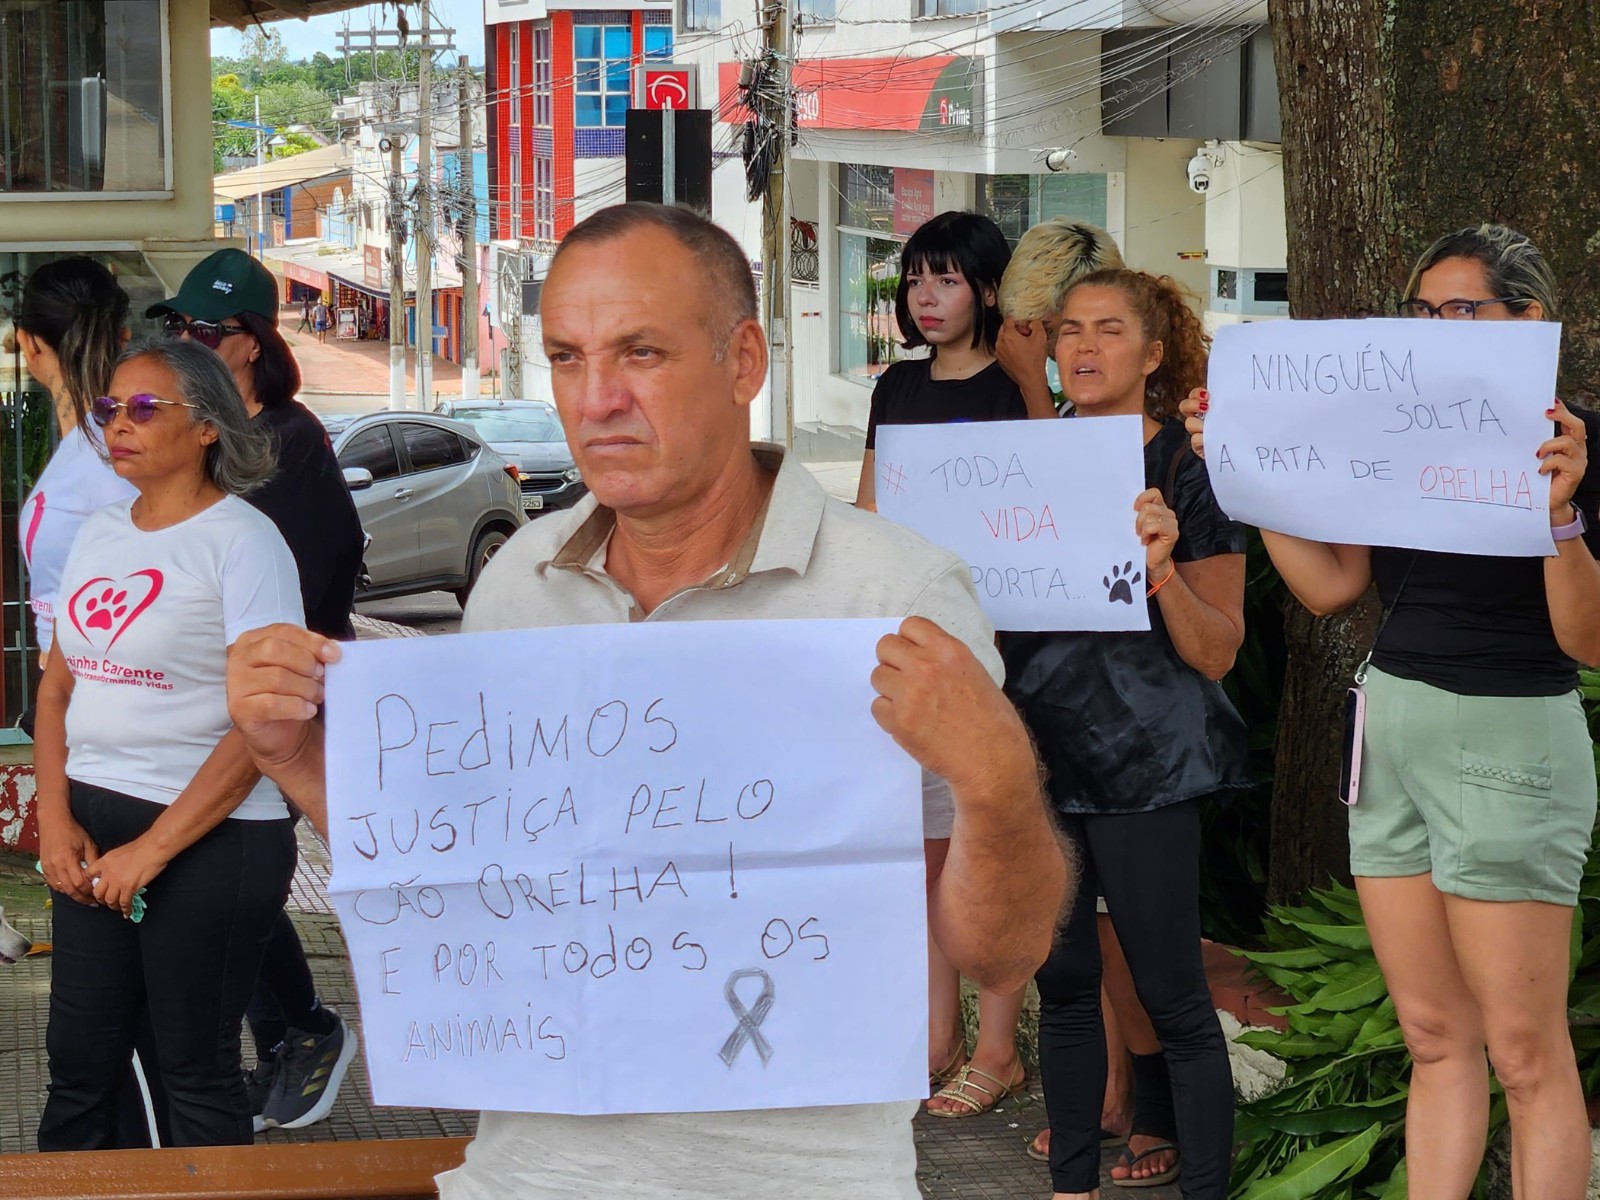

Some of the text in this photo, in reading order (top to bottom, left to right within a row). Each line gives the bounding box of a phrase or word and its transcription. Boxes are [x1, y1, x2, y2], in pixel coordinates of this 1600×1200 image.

[948, 101, 970, 125] Prime
[1251, 343, 1420, 397] NINGUÉM
[1382, 398, 1508, 436] SOLTA
[929, 452, 1033, 493] TODA
[1218, 444, 1236, 473] A
[1255, 445, 1326, 474] PATA
[1349, 459, 1394, 482] DE
[980, 504, 1060, 542] VIDA
[968, 565, 1086, 601] PORTA...
[84, 673, 174, 691] transformando vidas
[102, 659, 165, 681] Carente
[625, 778, 774, 834] PELO
[354, 874, 446, 925] CÃO
[477, 861, 688, 920] ORELHA
[381, 946, 401, 995] E
[434, 941, 504, 988] POR
[760, 917, 830, 961] OS
